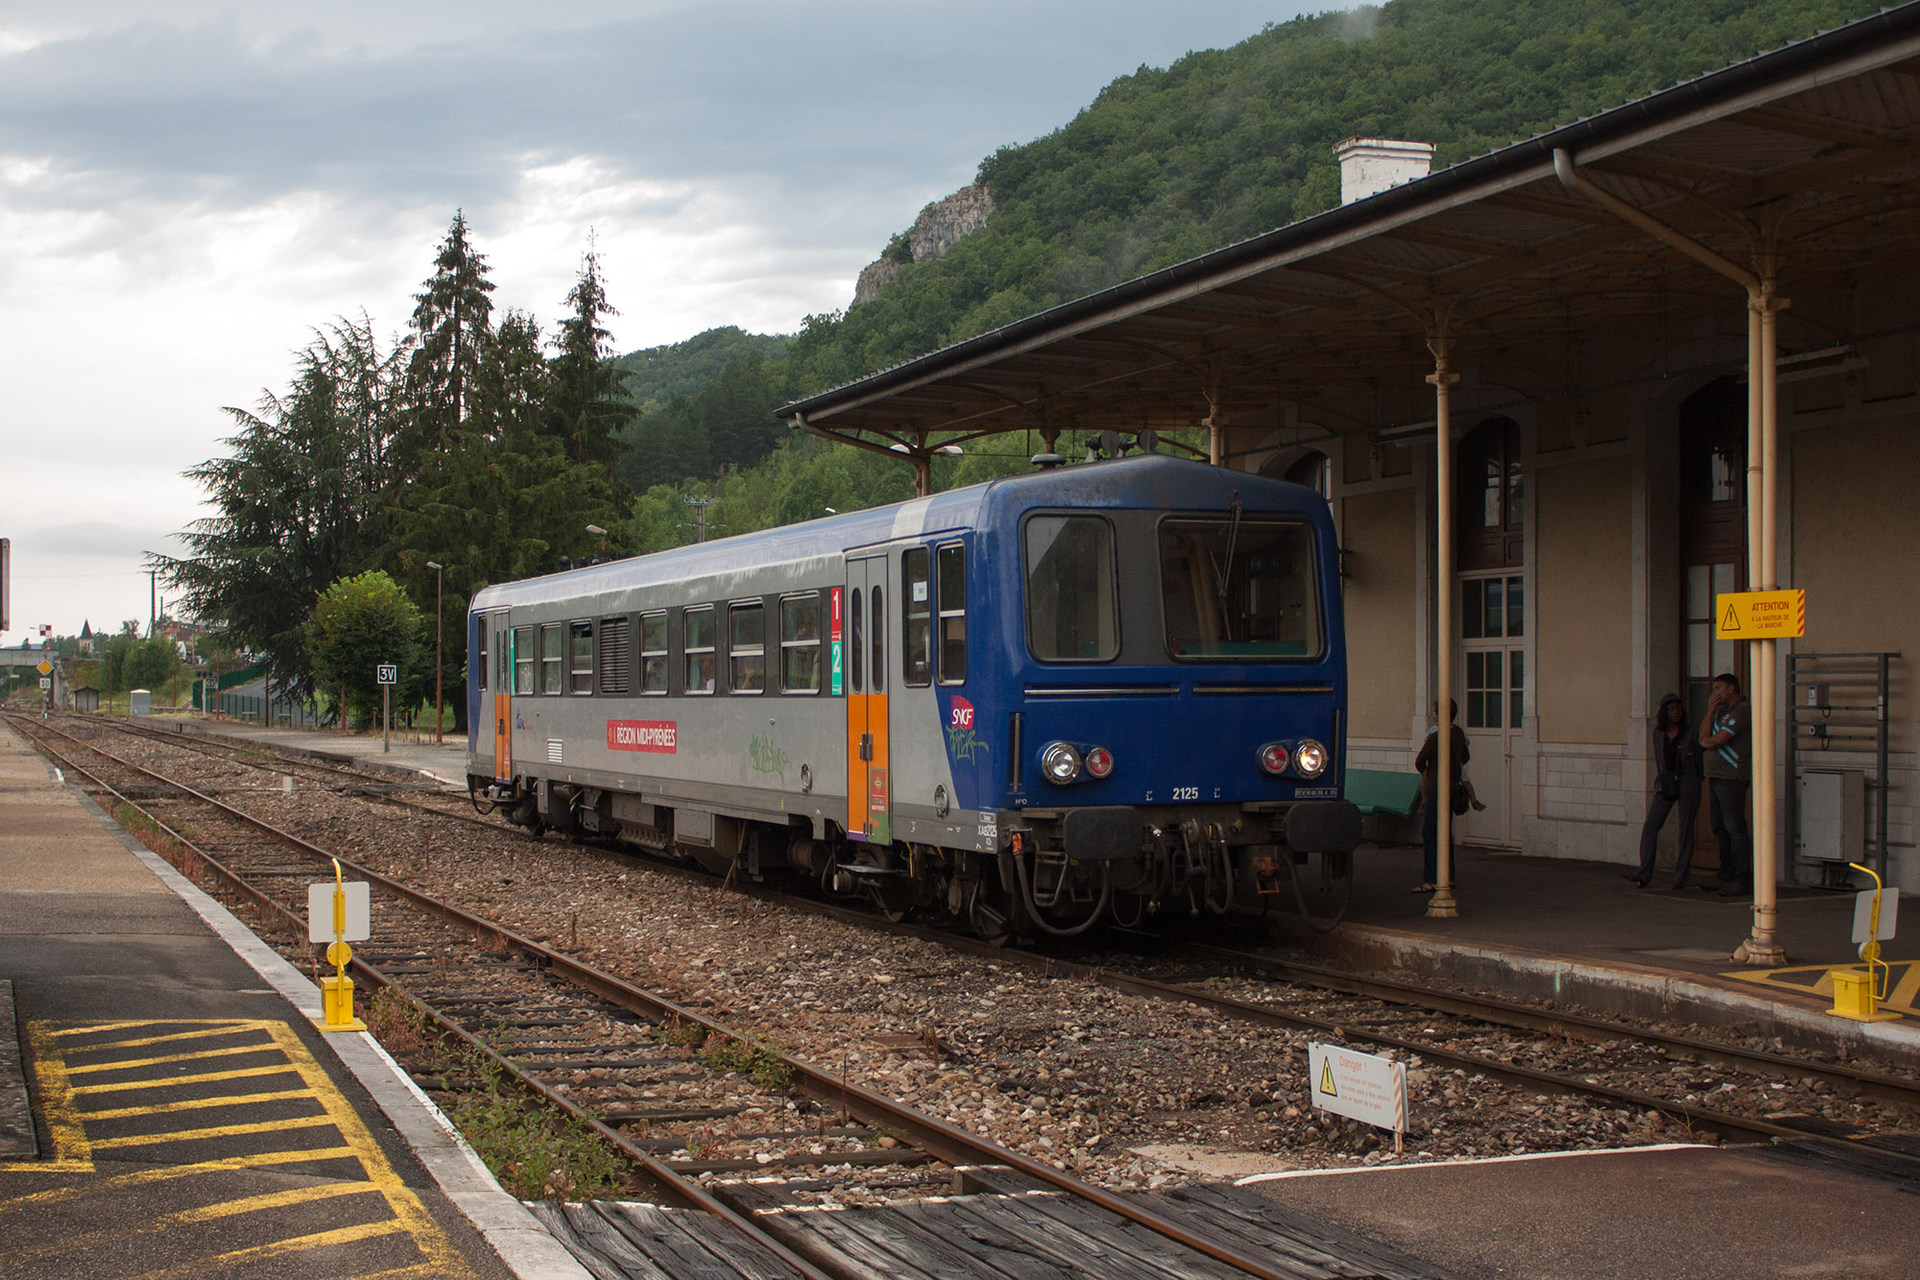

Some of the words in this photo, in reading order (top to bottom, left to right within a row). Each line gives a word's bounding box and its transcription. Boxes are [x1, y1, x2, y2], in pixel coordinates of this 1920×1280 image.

[833, 590, 839, 620] 1
[1751, 601, 1790, 612] ATTENTION
[833, 644, 841, 673] 2
[380, 668, 394, 681] 3V
[951, 708, 974, 725] SNCF
[616, 723, 636, 745] RÉGION
[637, 724, 676, 747] MIDI-PYRÉNÉES
[1172, 787, 1199, 800] 2125
[1339, 1055, 1362, 1072] Danger
